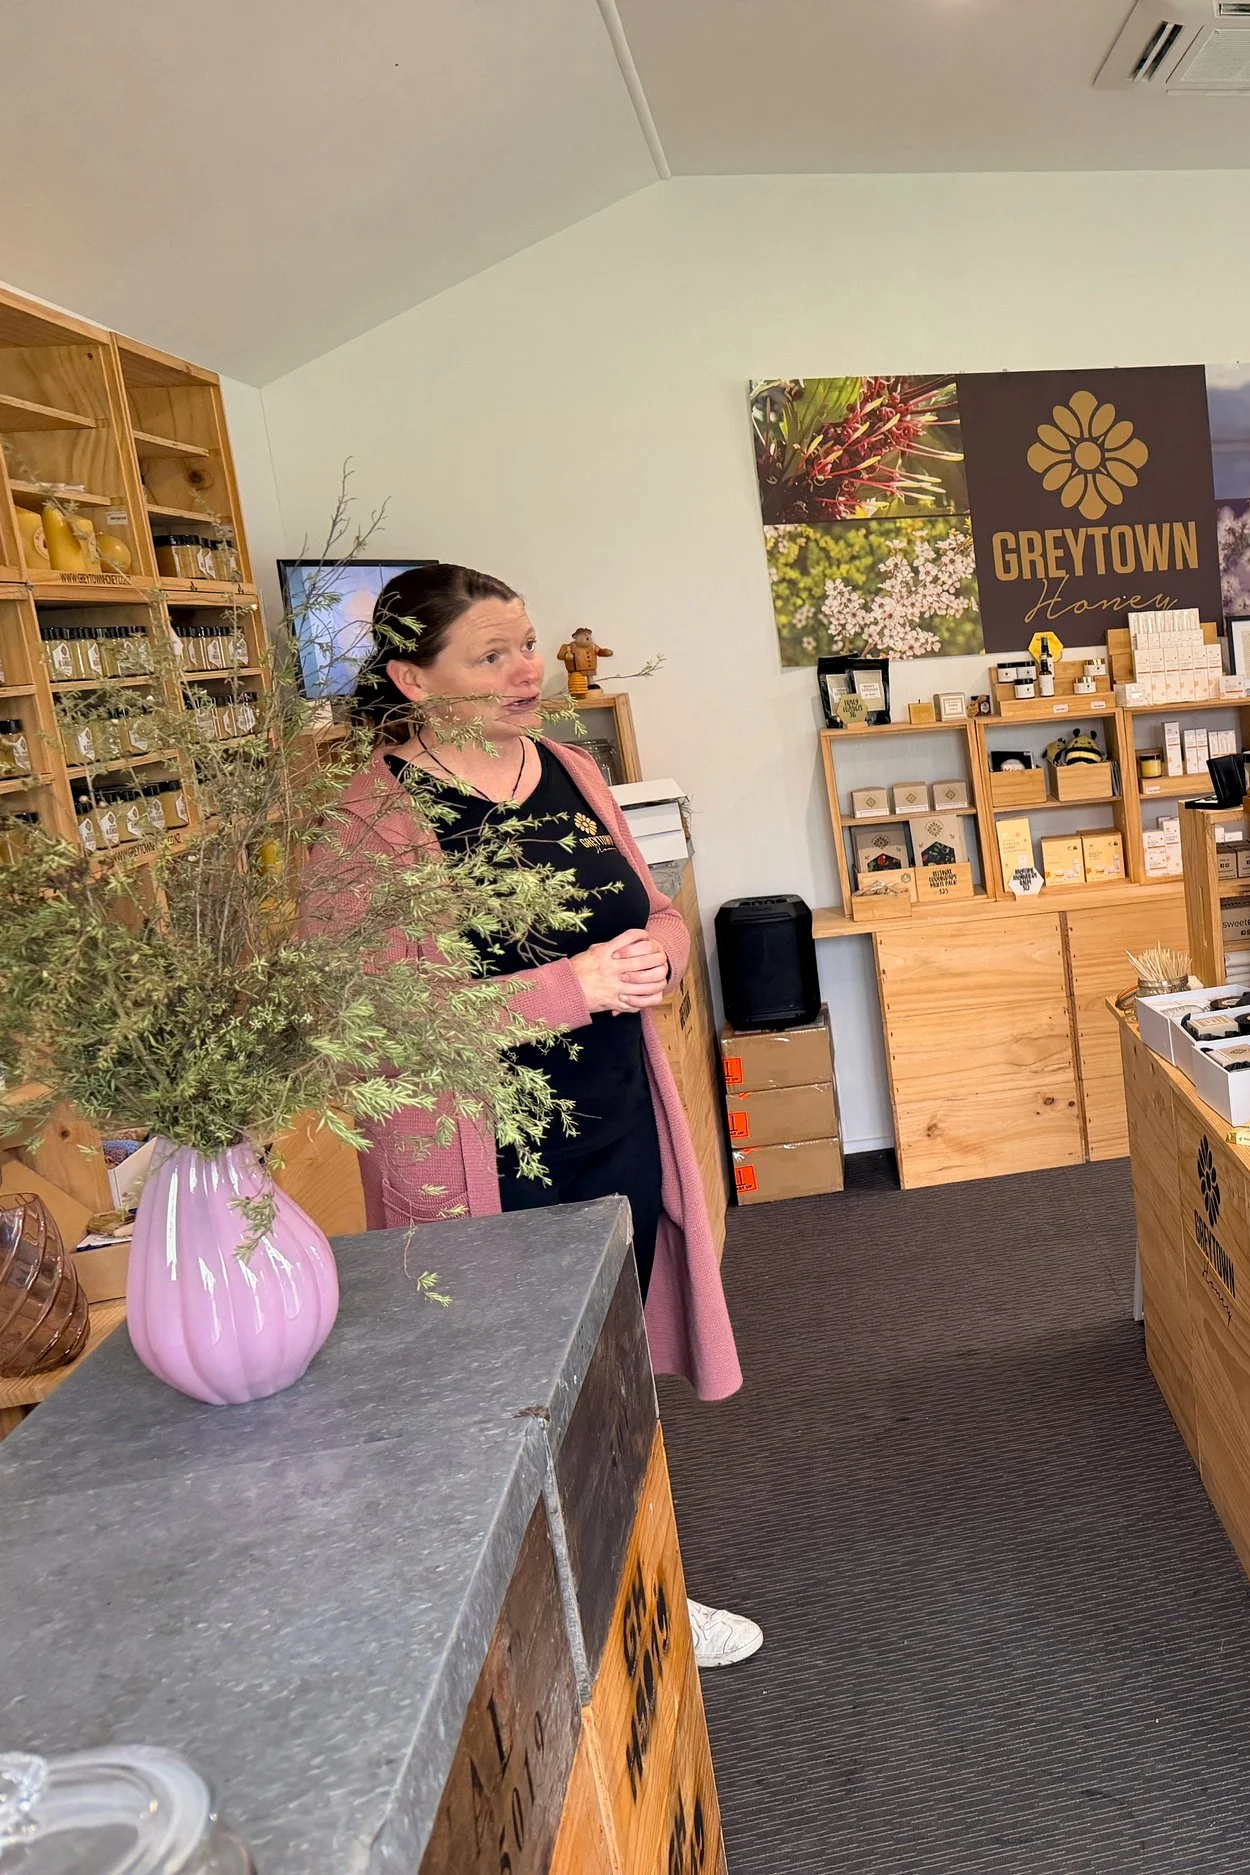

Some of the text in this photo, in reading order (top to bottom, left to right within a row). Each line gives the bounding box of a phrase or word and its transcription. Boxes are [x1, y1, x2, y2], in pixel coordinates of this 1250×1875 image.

[992, 521, 1199, 581] GREYTOWN
[1023, 574, 1178, 624] Honey
[1194, 1208, 1236, 1300] GREYTOWN
